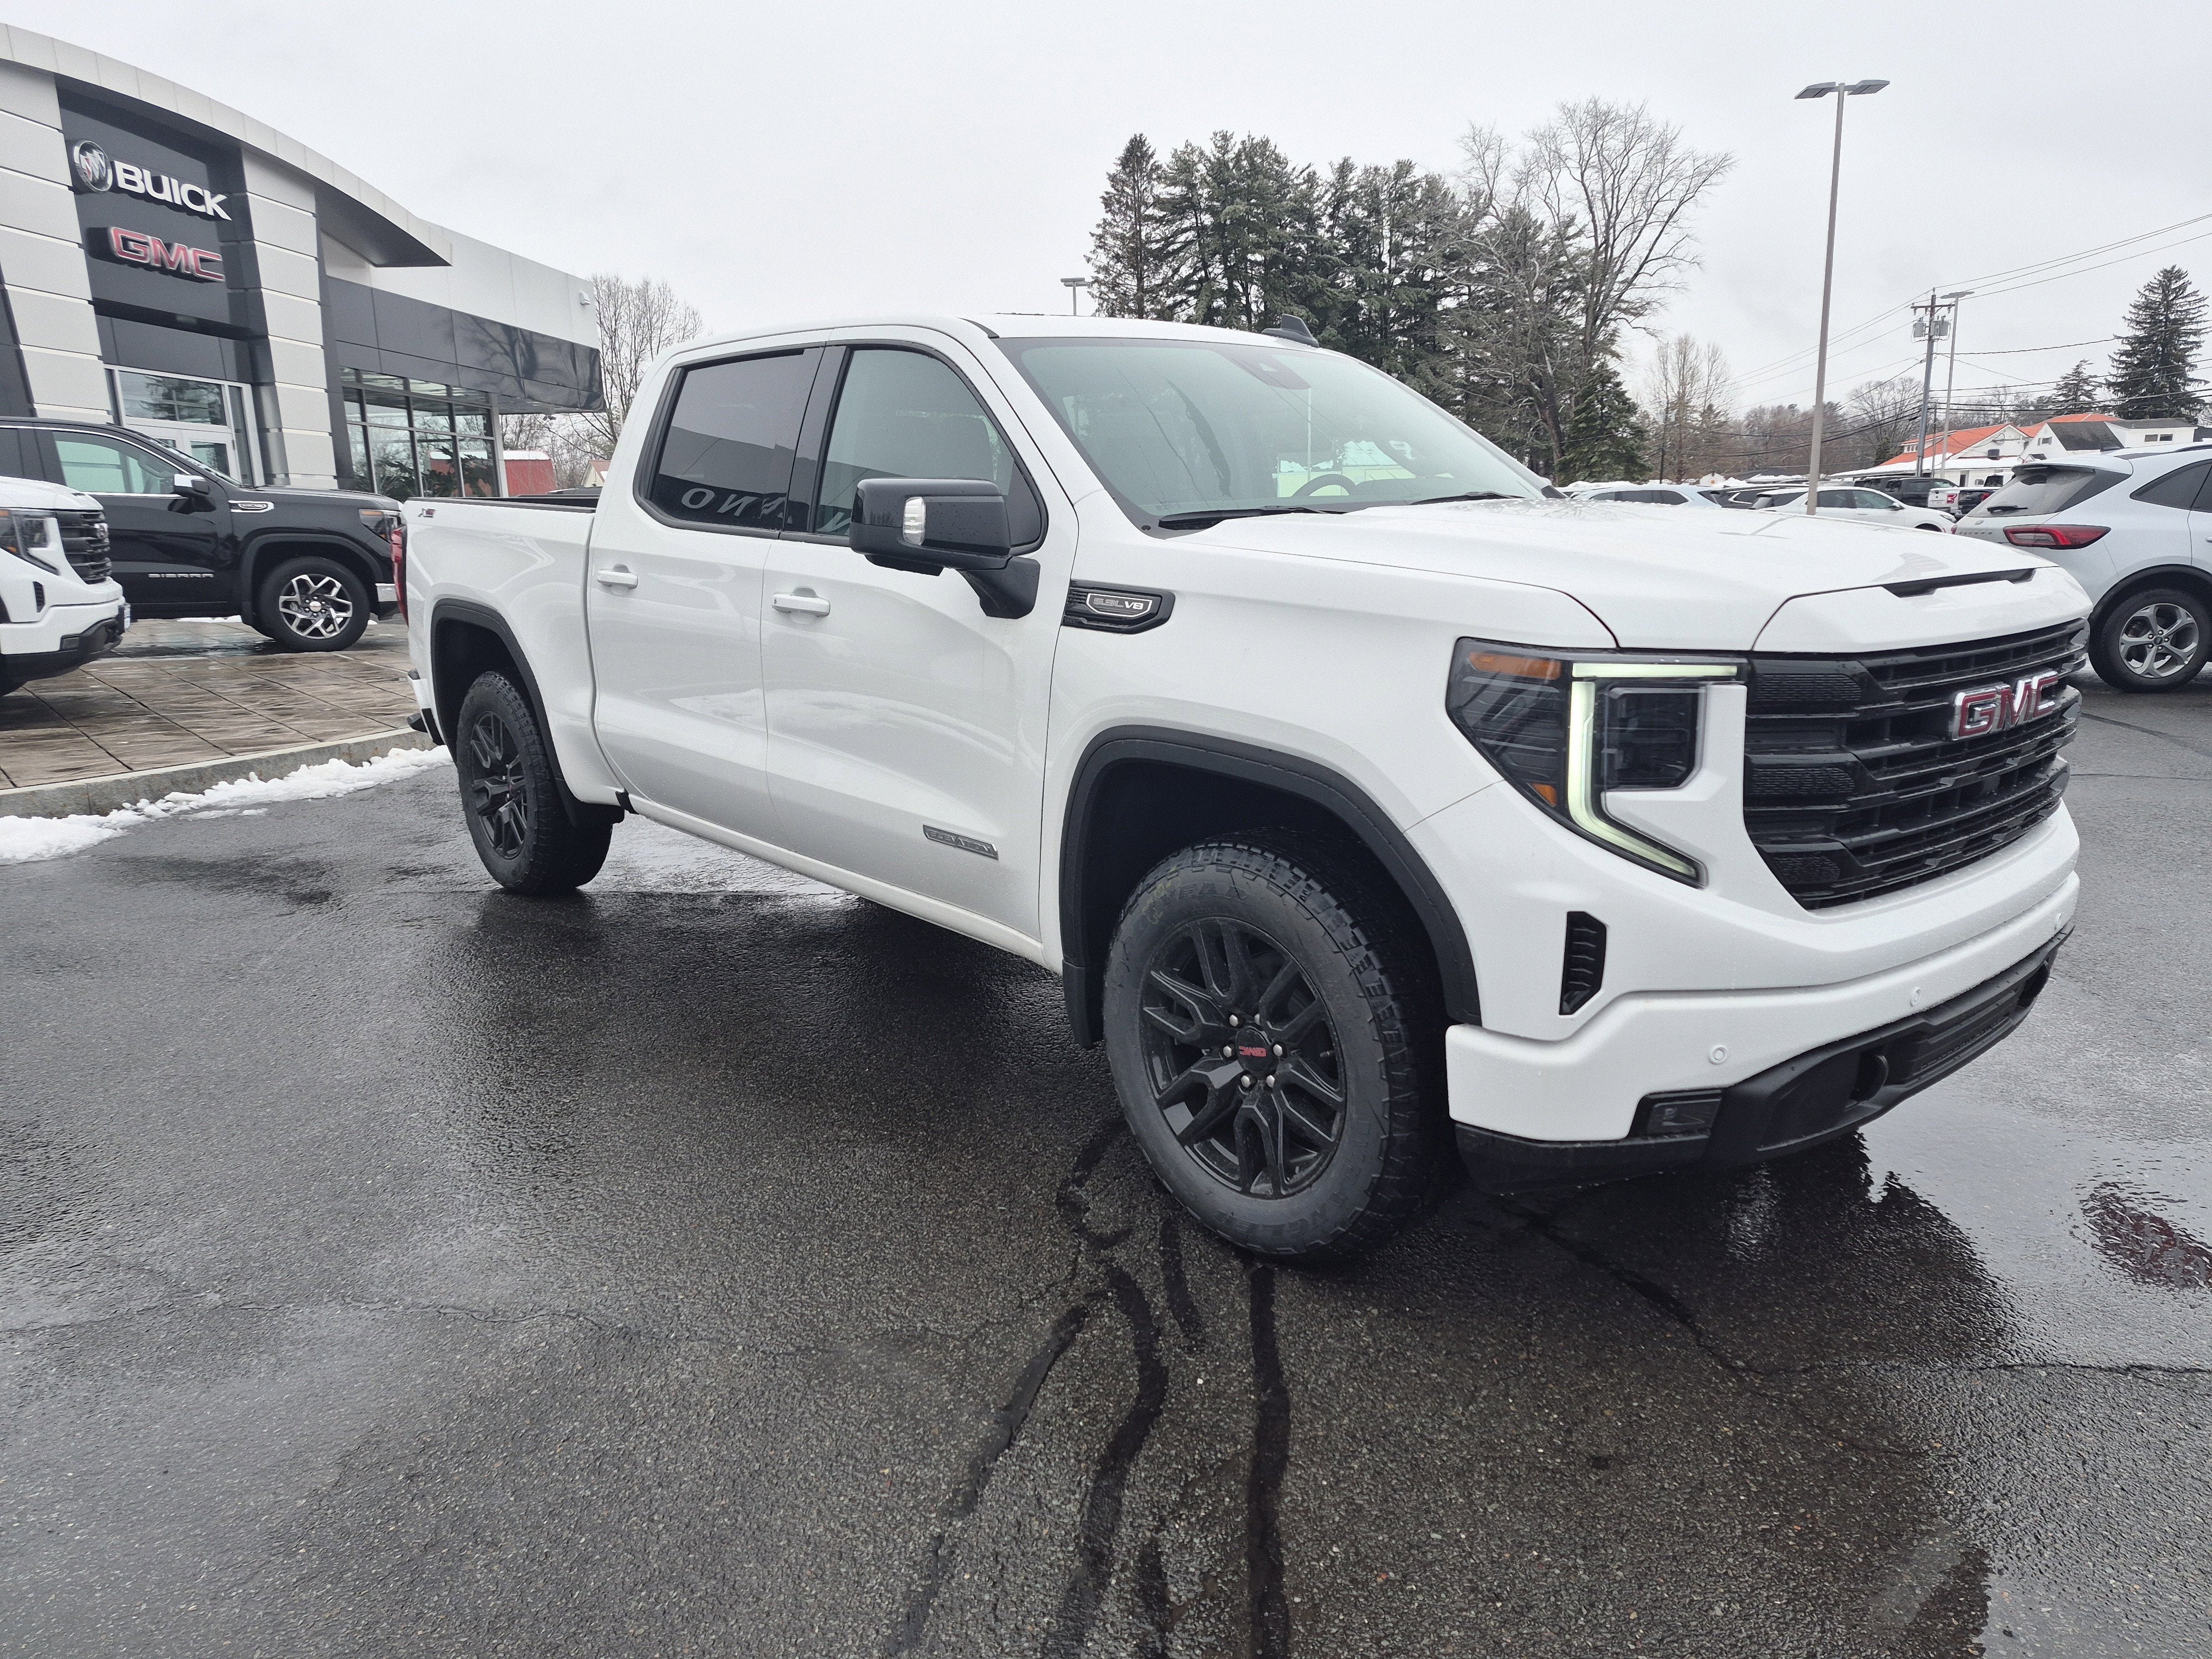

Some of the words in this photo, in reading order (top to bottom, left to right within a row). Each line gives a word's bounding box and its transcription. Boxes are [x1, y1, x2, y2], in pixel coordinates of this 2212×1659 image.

[113, 160, 232, 221] BUICK
[111, 227, 225, 282] GMC
[1125, 601, 1144, 610] V8
[1952, 671, 2059, 741] GMC
[1238, 1045, 1266, 1057] GMC
